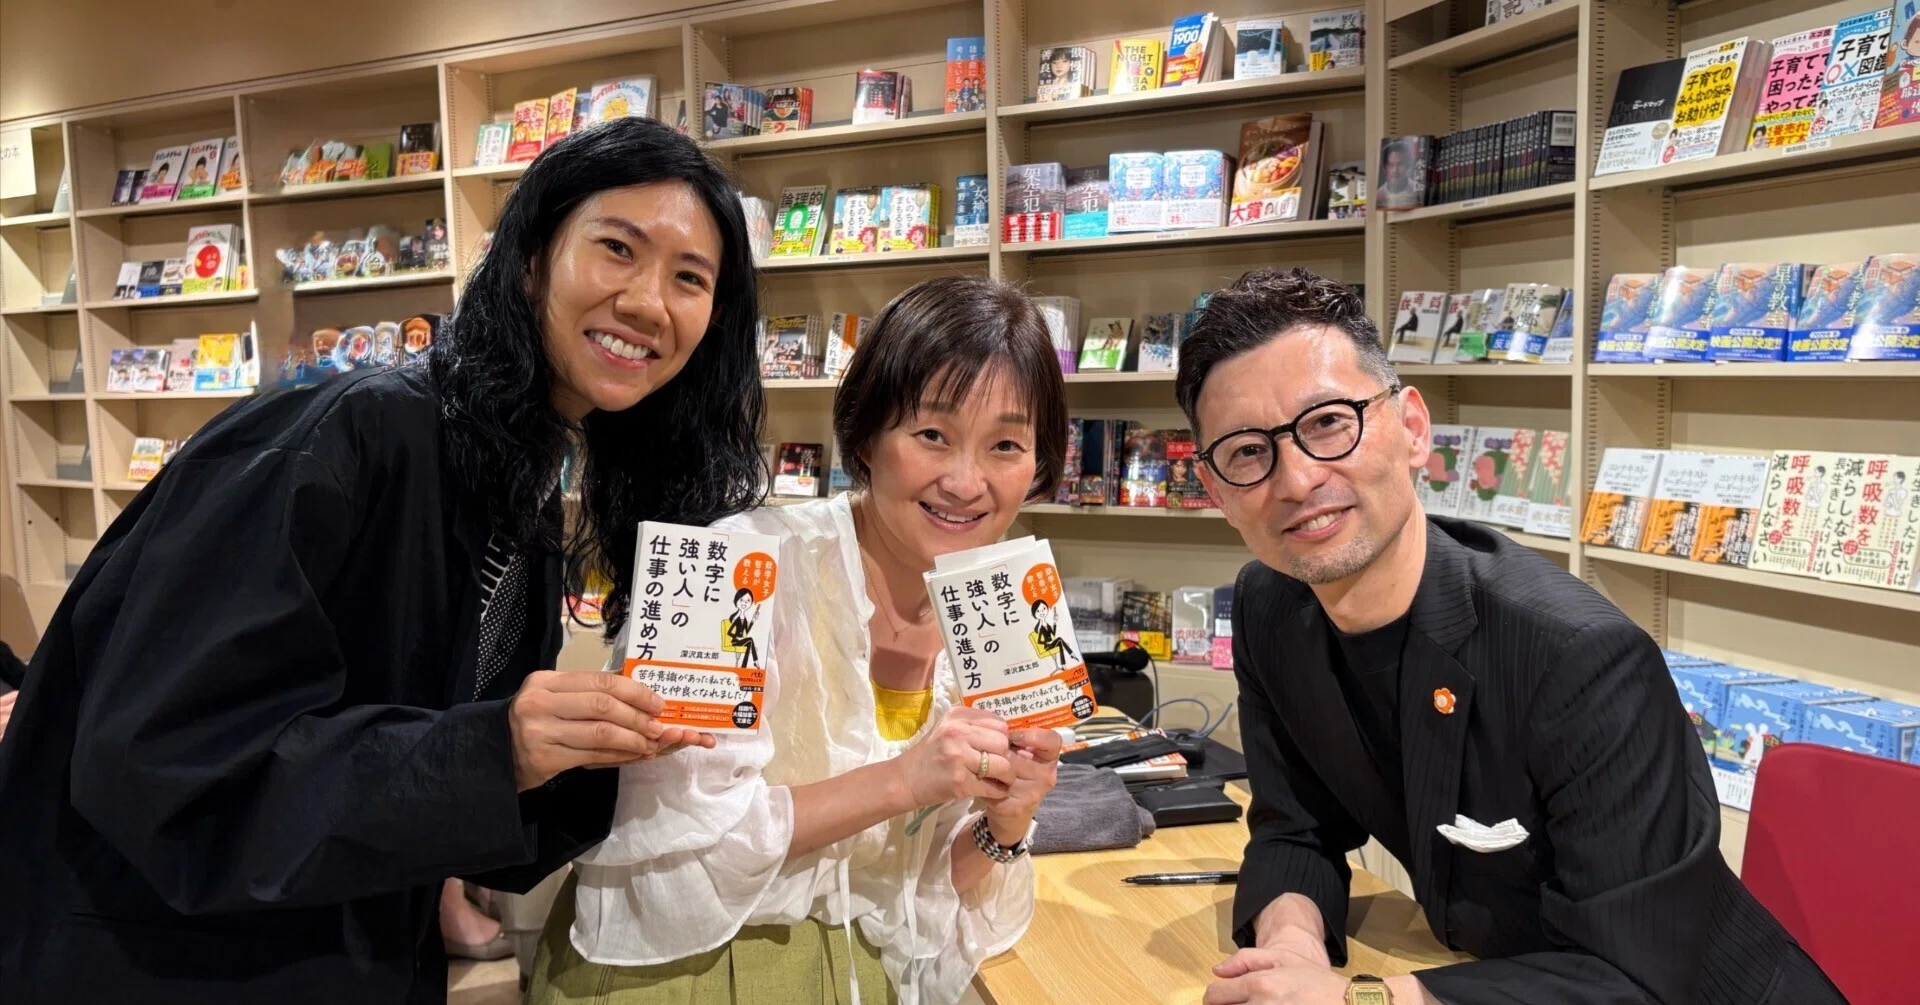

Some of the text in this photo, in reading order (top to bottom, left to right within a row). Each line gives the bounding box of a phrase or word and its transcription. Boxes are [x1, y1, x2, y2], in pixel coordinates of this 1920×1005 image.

[1173, 30, 1199, 46] 1900
[1687, 66, 1732, 91] 子育ての
[1767, 72, 1824, 98] 困ったら
[0, 144, 20, 160] の本
[781, 192, 823, 208] 論理的
[1023, 168, 1040, 213] 架空犯
[1082, 170, 1100, 213] 架空犯
[1232, 202, 1263, 222] 大賞
[1752, 454, 1789, 564] 減らしなさい
[1782, 454, 1811, 536] 呼吸数を
[1812, 456, 1847, 574] 長生きしたければ
[1857, 460, 1890, 547] 呼吸数を
[1824, 458, 1865, 576] 減らしなさい
[671, 538, 700, 628] 強い人」の
[704, 532, 730, 602] 「数字に
[742, 558, 752, 585] 教える
[762, 560, 774, 598] 数学女子
[637, 534, 672, 660] 仕事の進め方
[990, 564, 1020, 626] 「数字に
[940, 585, 982, 690] 仕事の進め方
[965, 580, 1000, 654] 強い人」の
[680, 650, 720, 660] 深沢真太郎
[1003, 661, 1040, 676] 深沢真太郎
[638, 669, 736, 688] 苦手意識があった私でも、
[990, 688, 1078, 716] 字と仲良くなれました!
